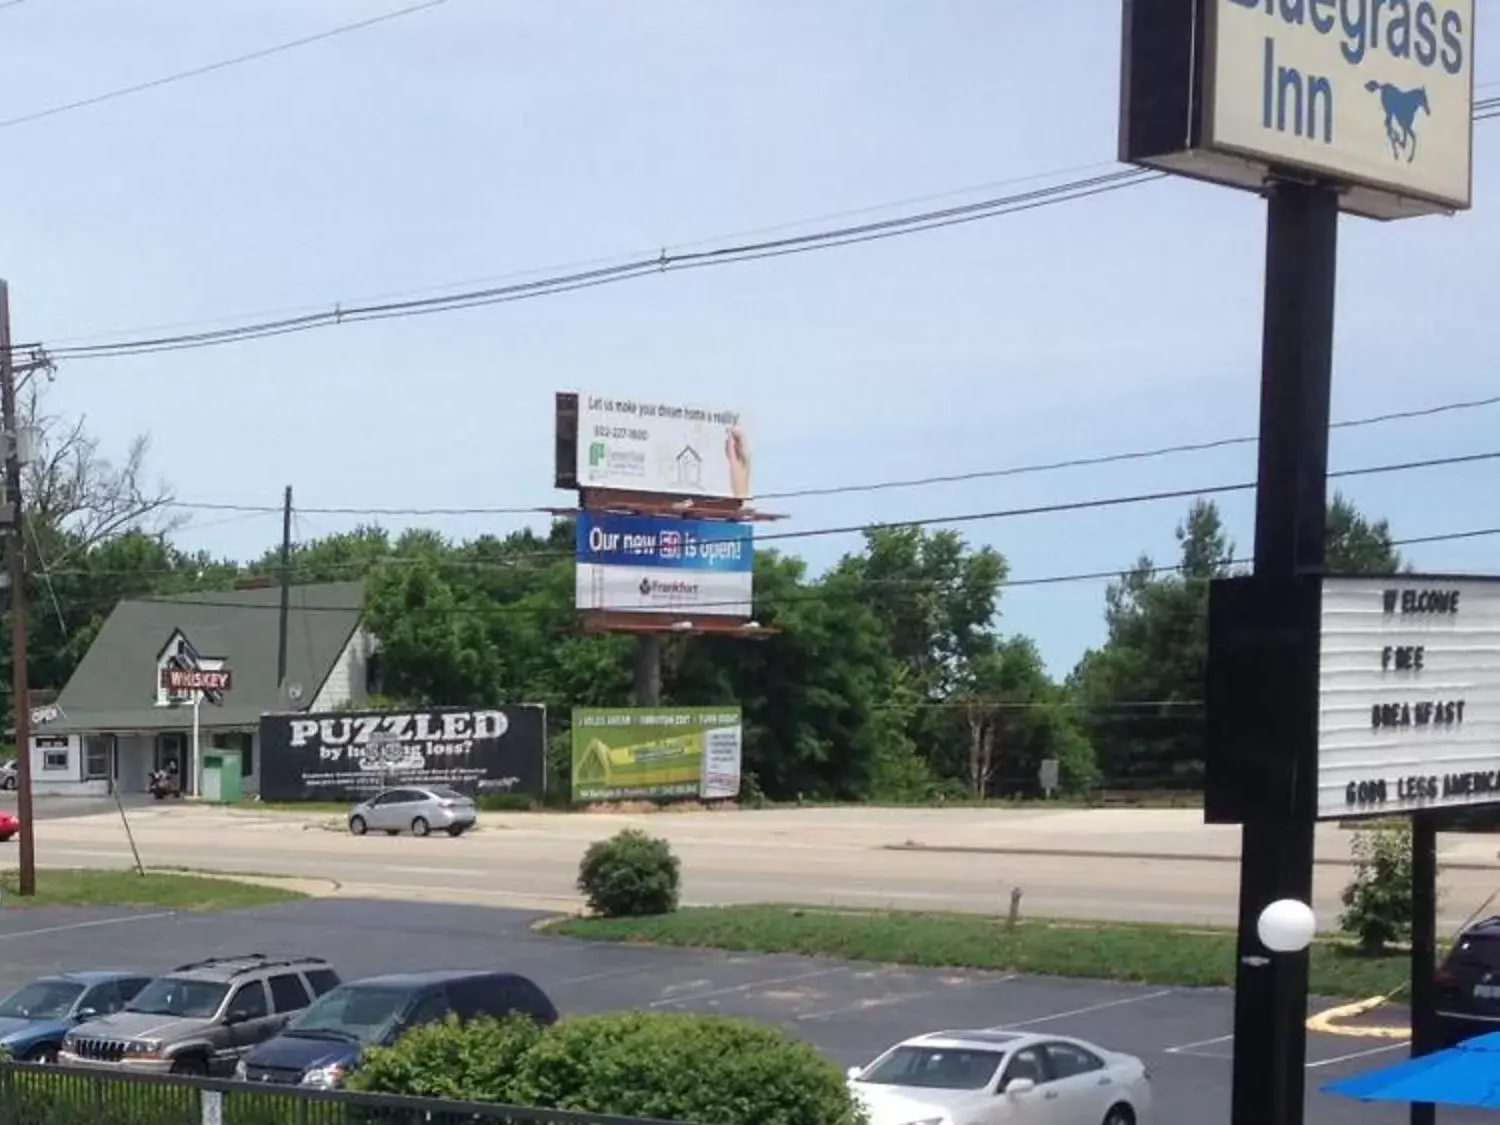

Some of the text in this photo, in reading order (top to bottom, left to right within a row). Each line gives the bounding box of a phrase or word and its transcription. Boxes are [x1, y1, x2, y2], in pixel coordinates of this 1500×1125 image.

[1228, 0, 1463, 75] egrass
[1263, 37, 1333, 144] Inn
[589, 528, 617, 552] Our
[623, 534, 657, 556] new
[684, 532, 698, 557] is
[700, 538, 741, 565] open!
[1383, 589, 1460, 613] WELCOME
[170, 670, 229, 688] WHISKEY
[289, 710, 509, 746] PUZZLED
[320, 745, 343, 761] by
[426, 740, 472, 756] loss?
